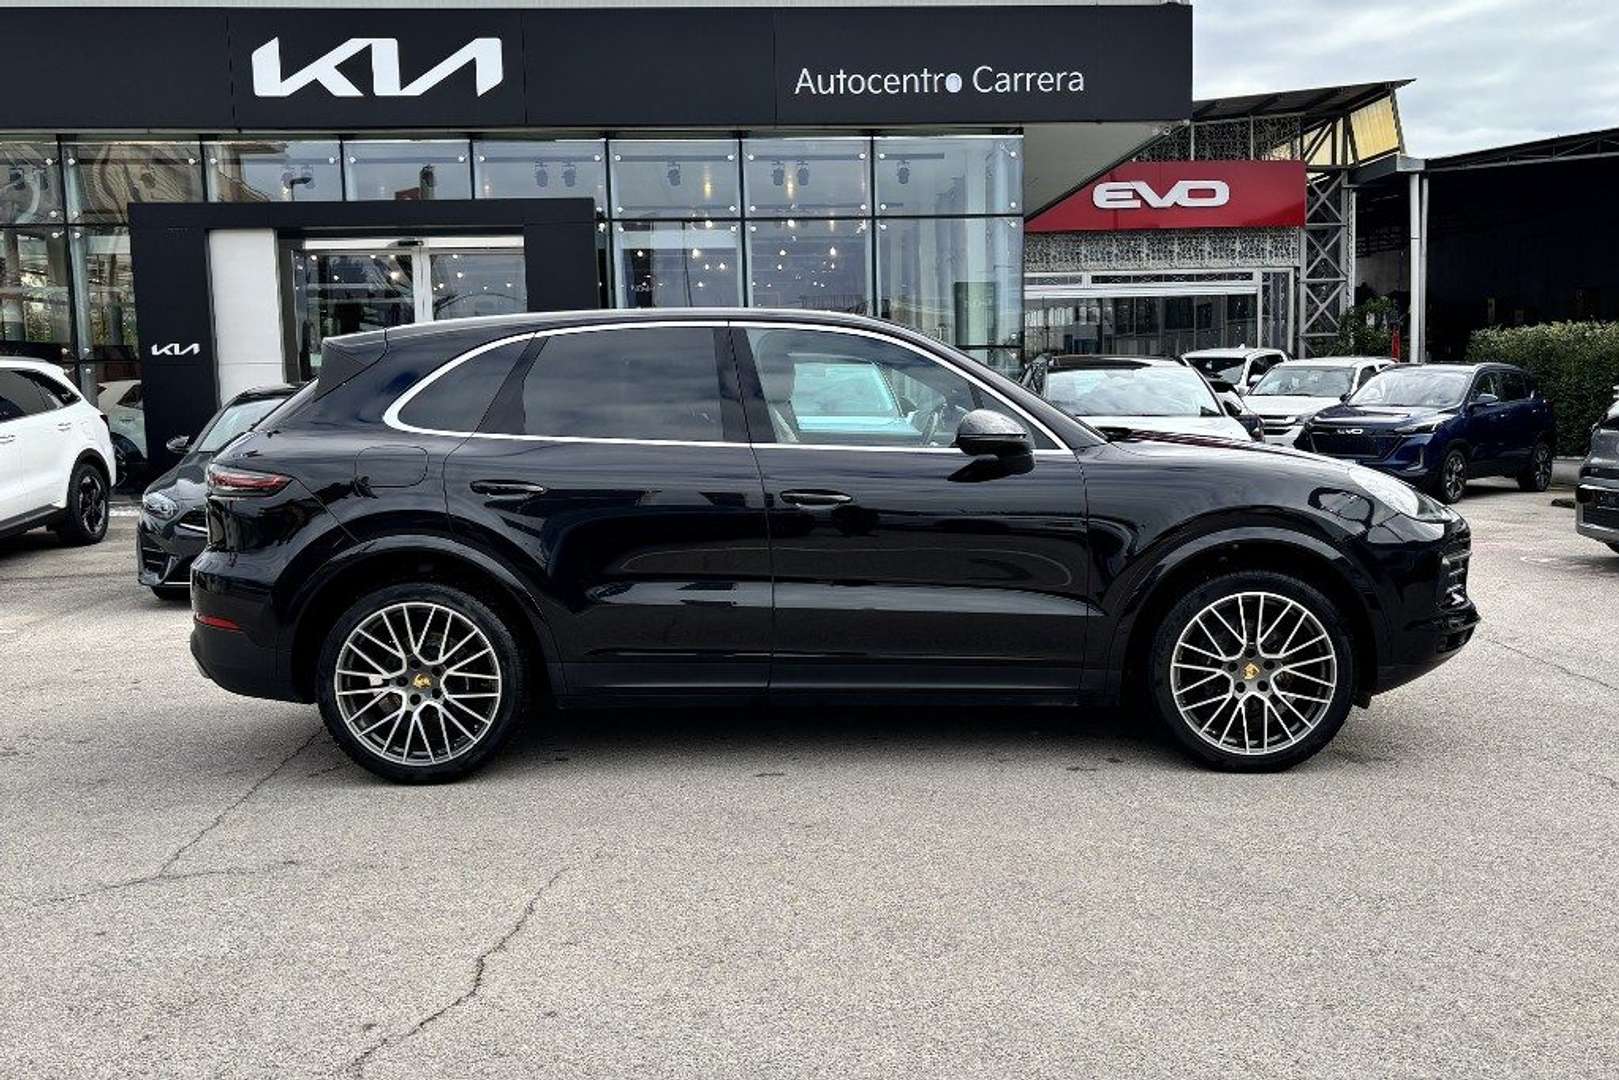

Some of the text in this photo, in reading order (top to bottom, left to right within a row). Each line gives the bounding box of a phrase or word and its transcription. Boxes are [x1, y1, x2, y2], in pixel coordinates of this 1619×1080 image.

[251, 36, 503, 97] KIA
[795, 65, 1085, 95] Autocentro Carrera
[1092, 180, 1230, 209] EVO
[151, 343, 200, 356] KIA
